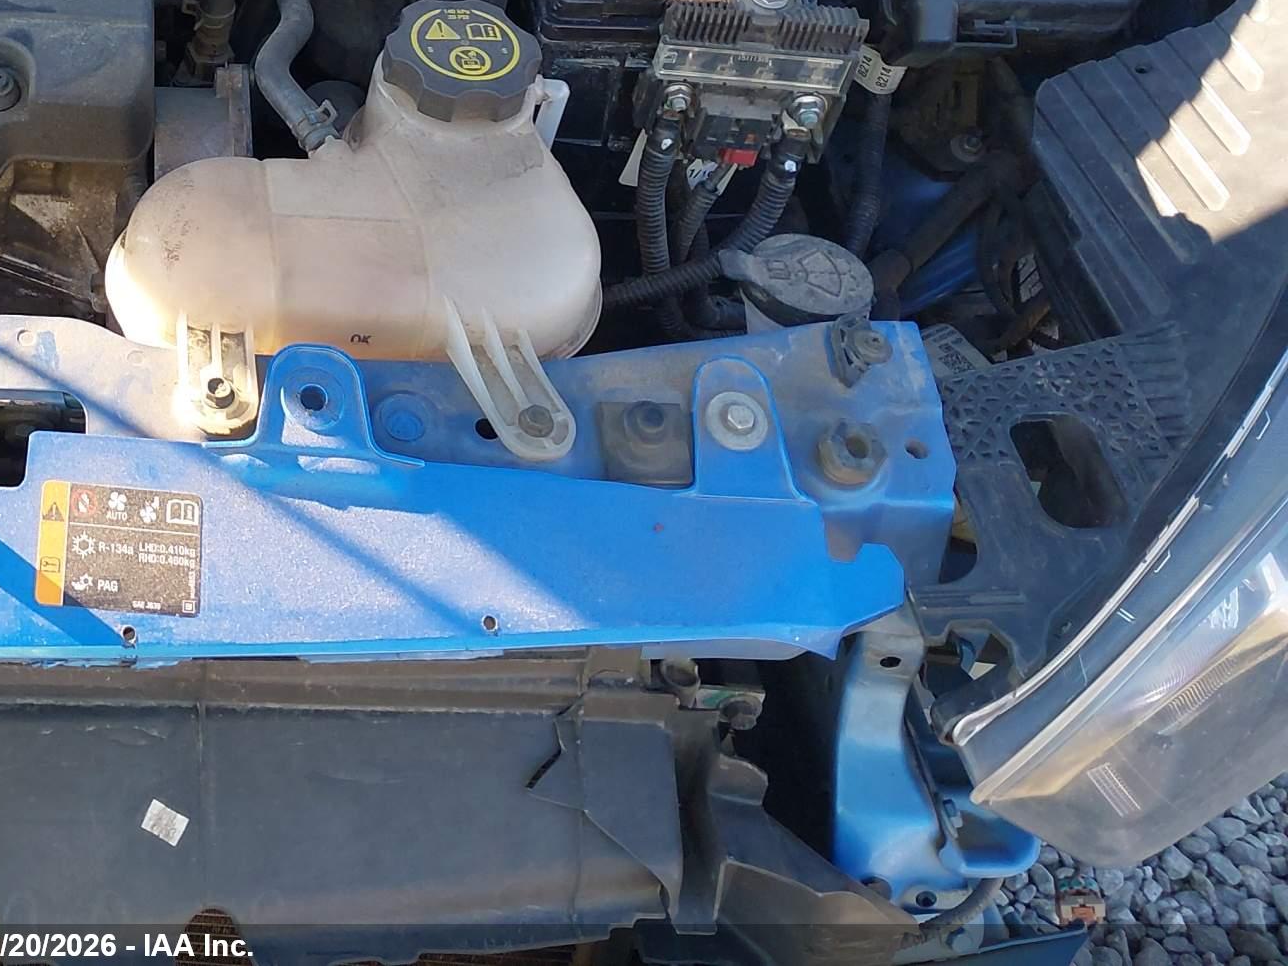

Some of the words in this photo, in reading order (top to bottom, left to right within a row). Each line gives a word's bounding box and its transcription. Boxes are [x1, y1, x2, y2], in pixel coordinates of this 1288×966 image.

[106, 511, 127, 521] AUTO
[98, 542, 134, 555] R-134a
[97, 580, 118, 592] PAG
